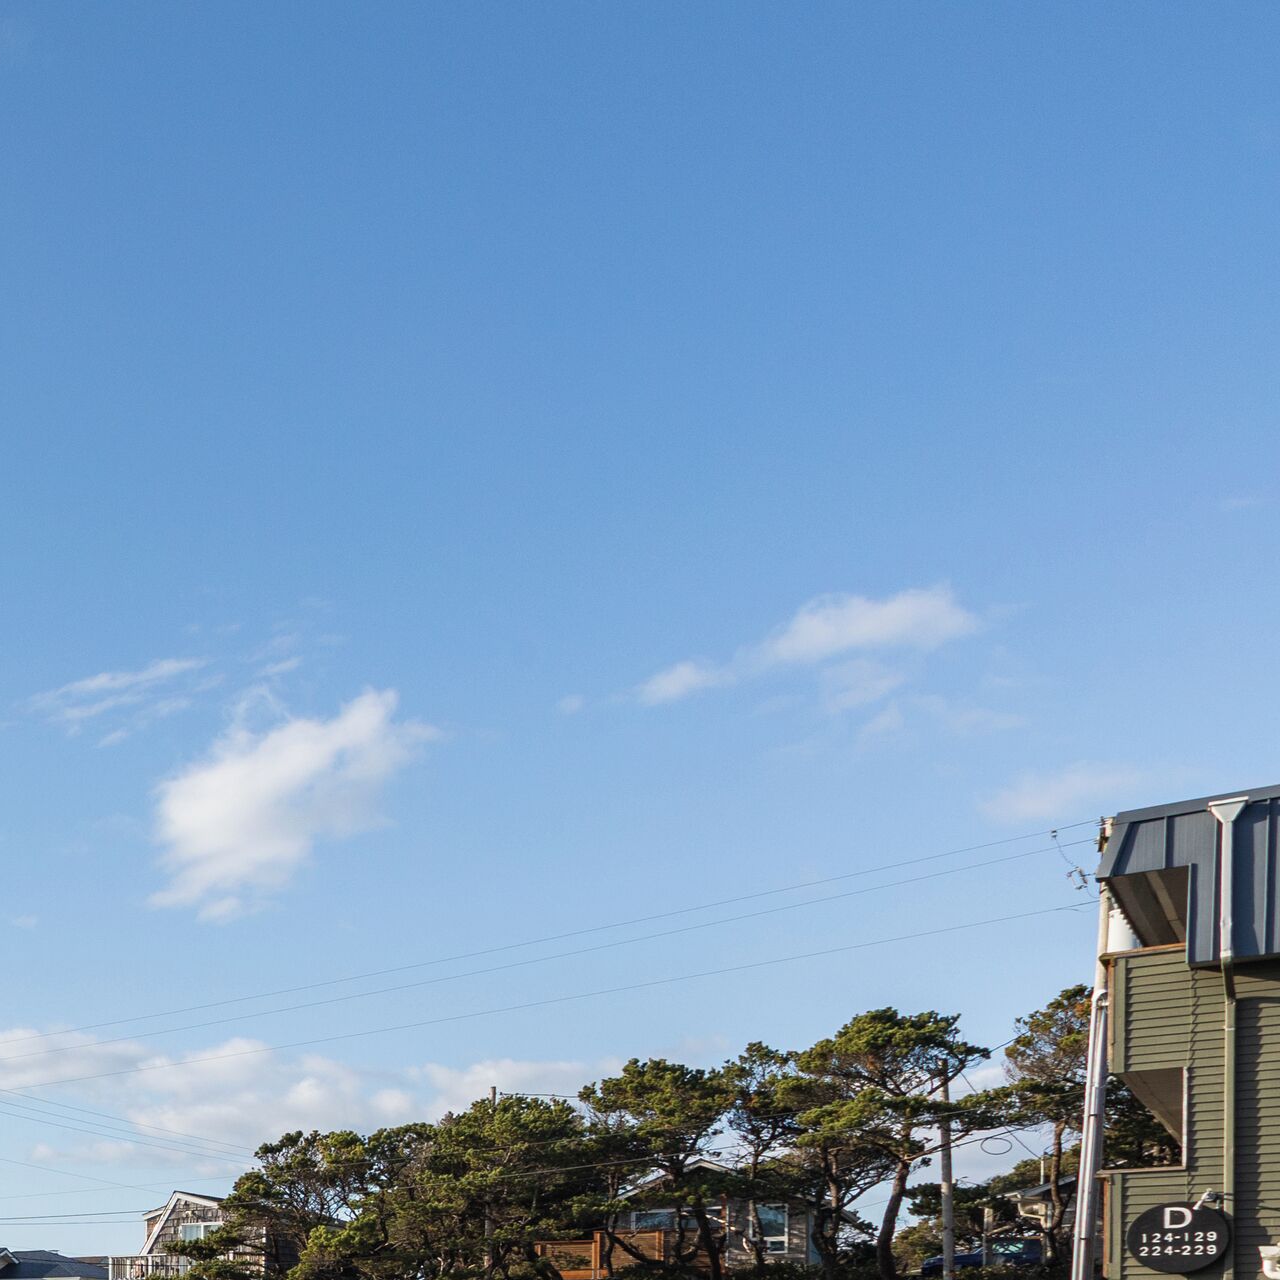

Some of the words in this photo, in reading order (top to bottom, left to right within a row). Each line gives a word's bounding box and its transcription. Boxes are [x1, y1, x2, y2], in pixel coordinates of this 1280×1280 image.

[1164, 1207, 1192, 1229] D
[1142, 1231, 1217, 1243] 124-129
[1139, 1245, 1217, 1256] 224-229
